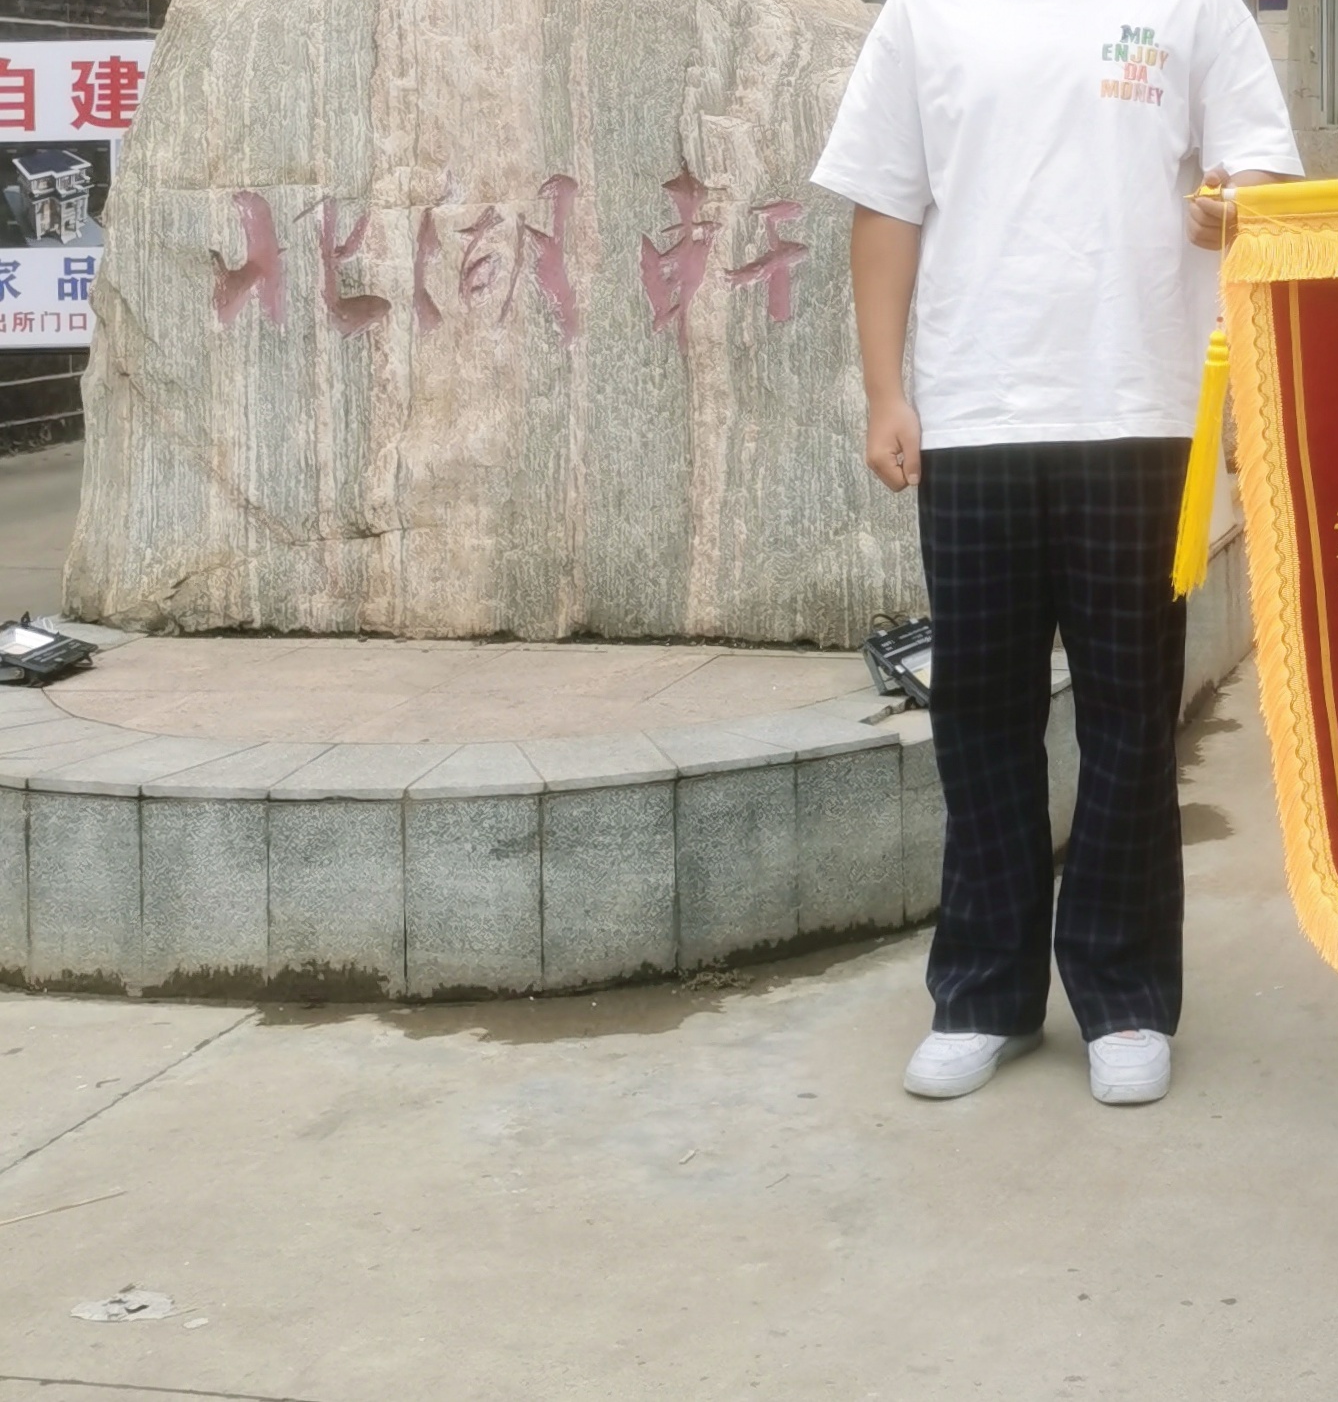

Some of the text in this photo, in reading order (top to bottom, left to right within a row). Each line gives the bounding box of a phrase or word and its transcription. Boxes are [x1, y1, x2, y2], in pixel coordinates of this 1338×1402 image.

[1120, 24, 1160, 47] MR.
[1101, 43, 1169, 70] ENJOY
[1123, 62, 1149, 84] DA
[1100, 78, 1164, 107] MONEY
